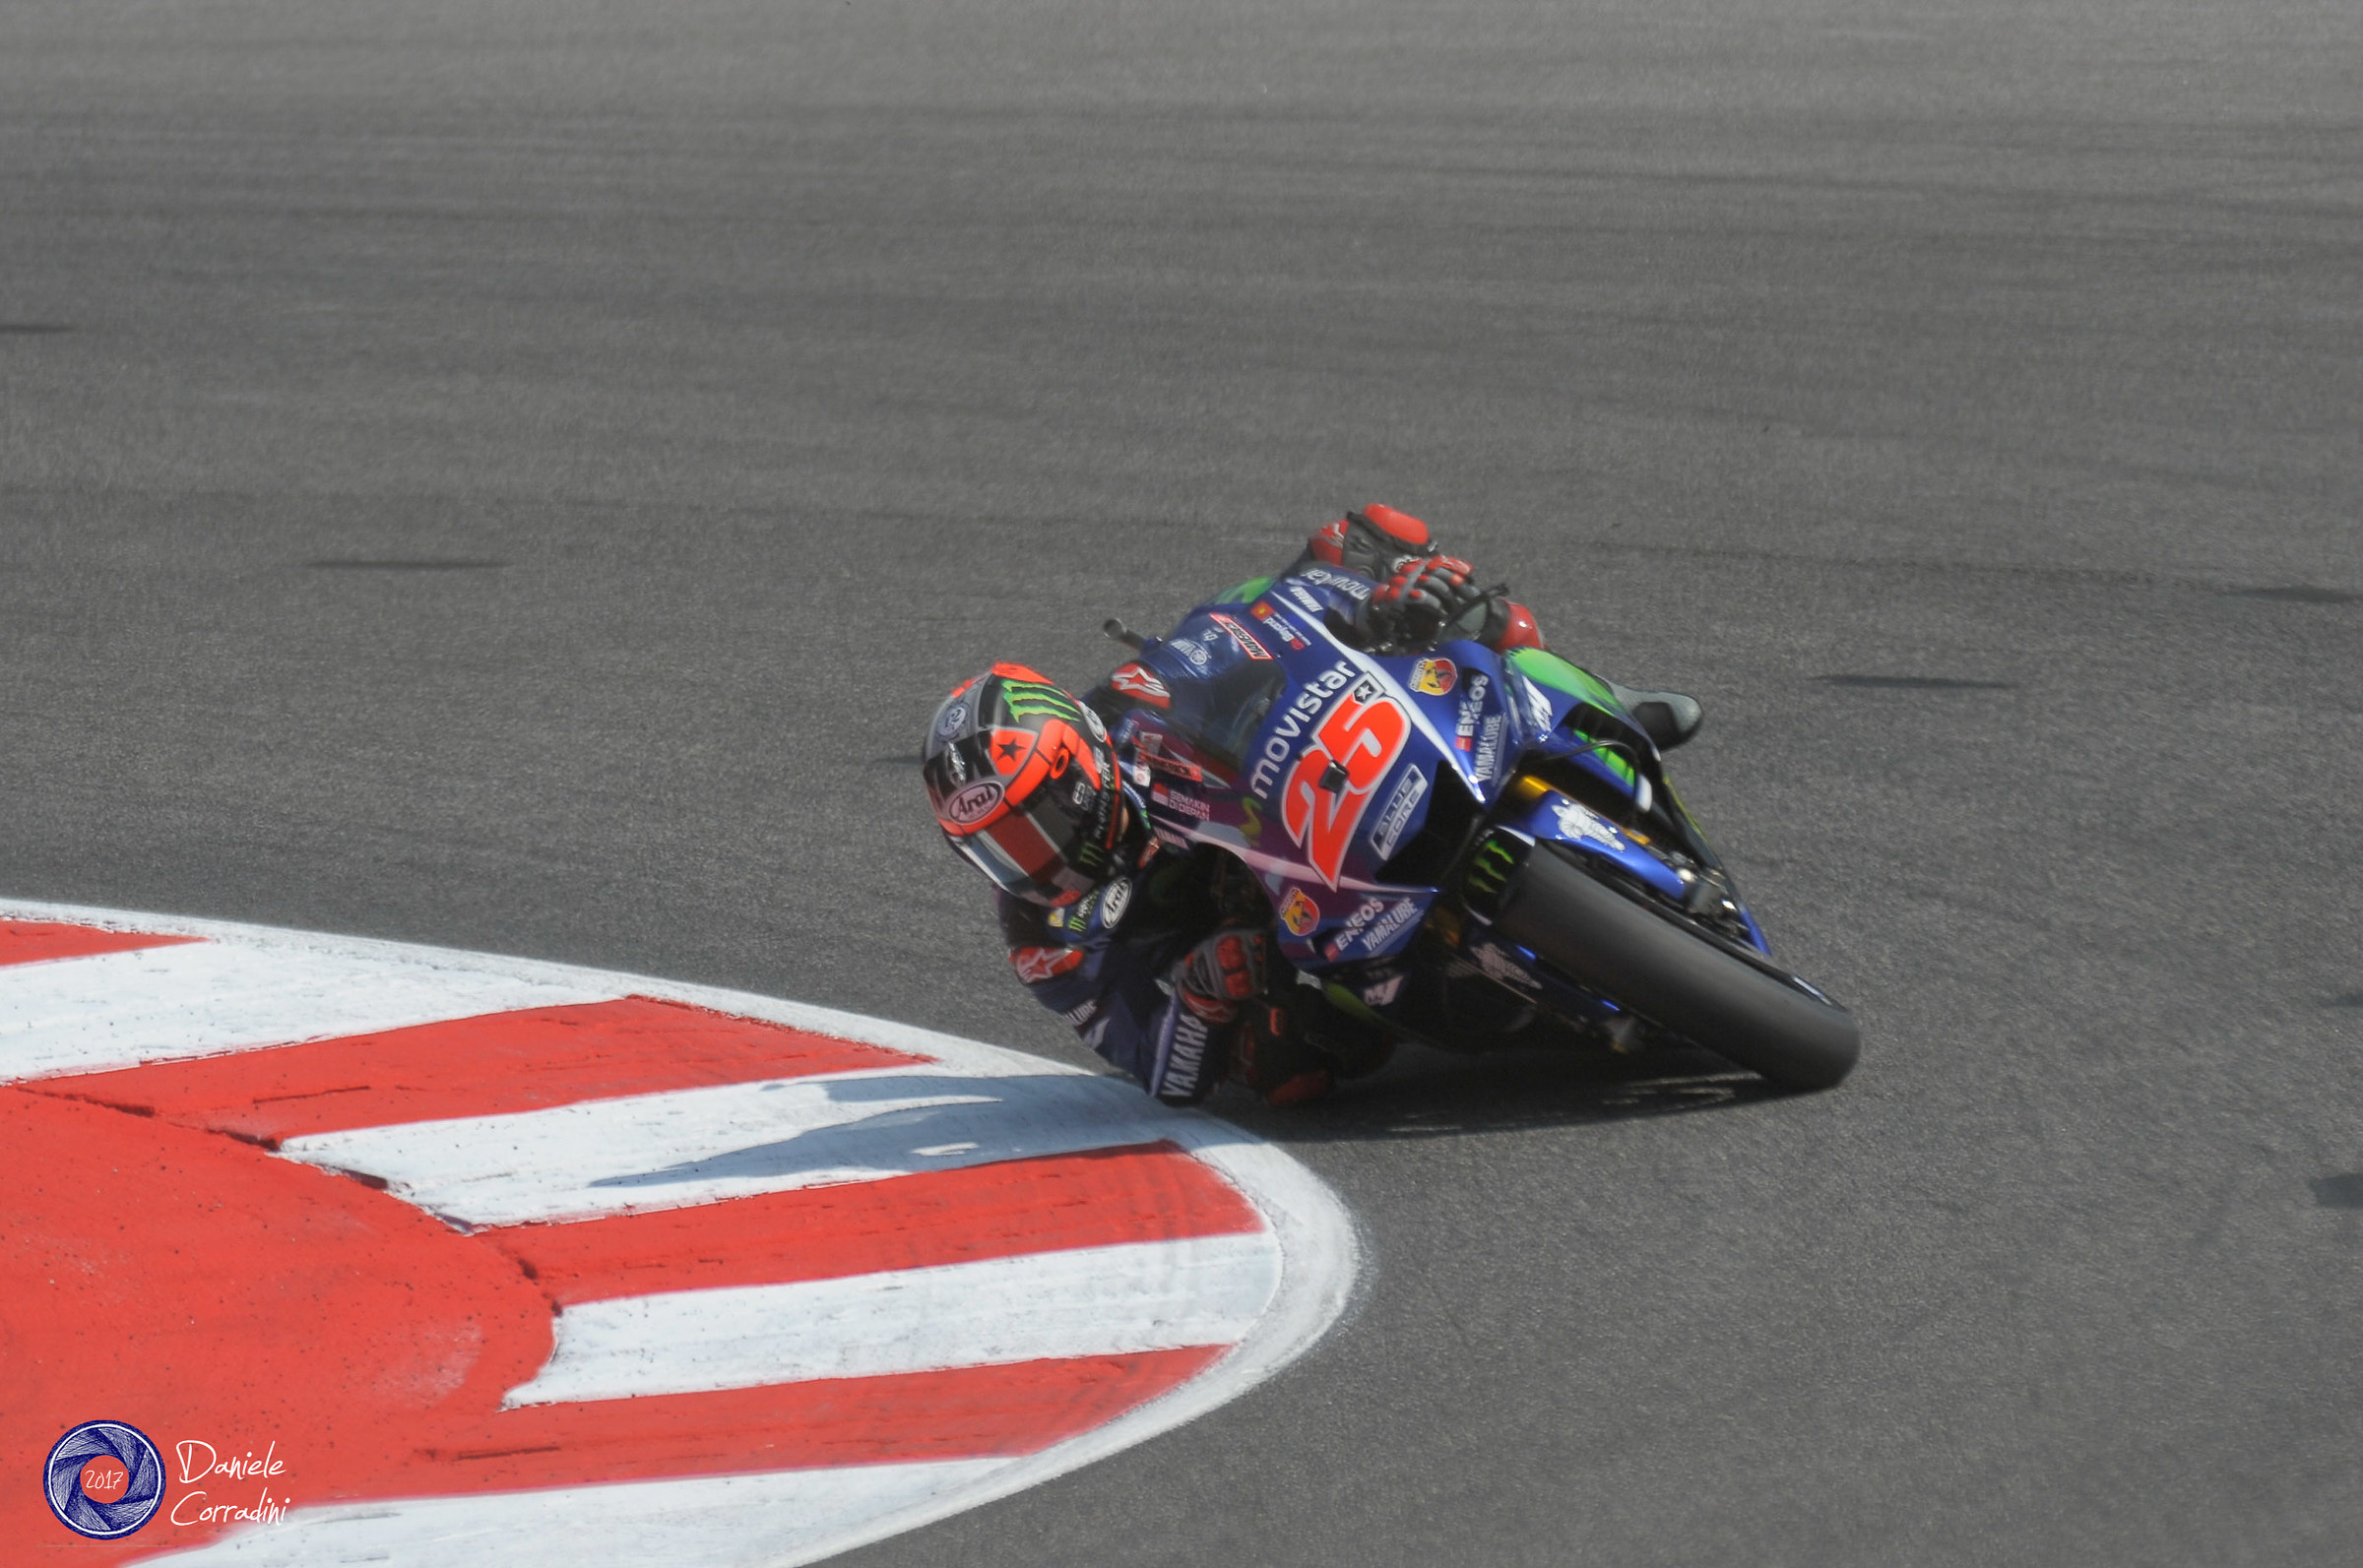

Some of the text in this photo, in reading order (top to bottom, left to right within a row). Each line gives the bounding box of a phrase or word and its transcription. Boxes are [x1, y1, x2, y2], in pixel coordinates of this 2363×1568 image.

[1249, 659, 1357, 800] movistar
[1473, 714, 1502, 782] YAMALUBE
[958, 784, 994, 817] Arai
[1282, 691, 1412, 894] 25
[1385, 790, 1421, 849] CORE
[1335, 897, 1384, 951] ENEOS
[1361, 897, 1419, 952] YAMALUBE
